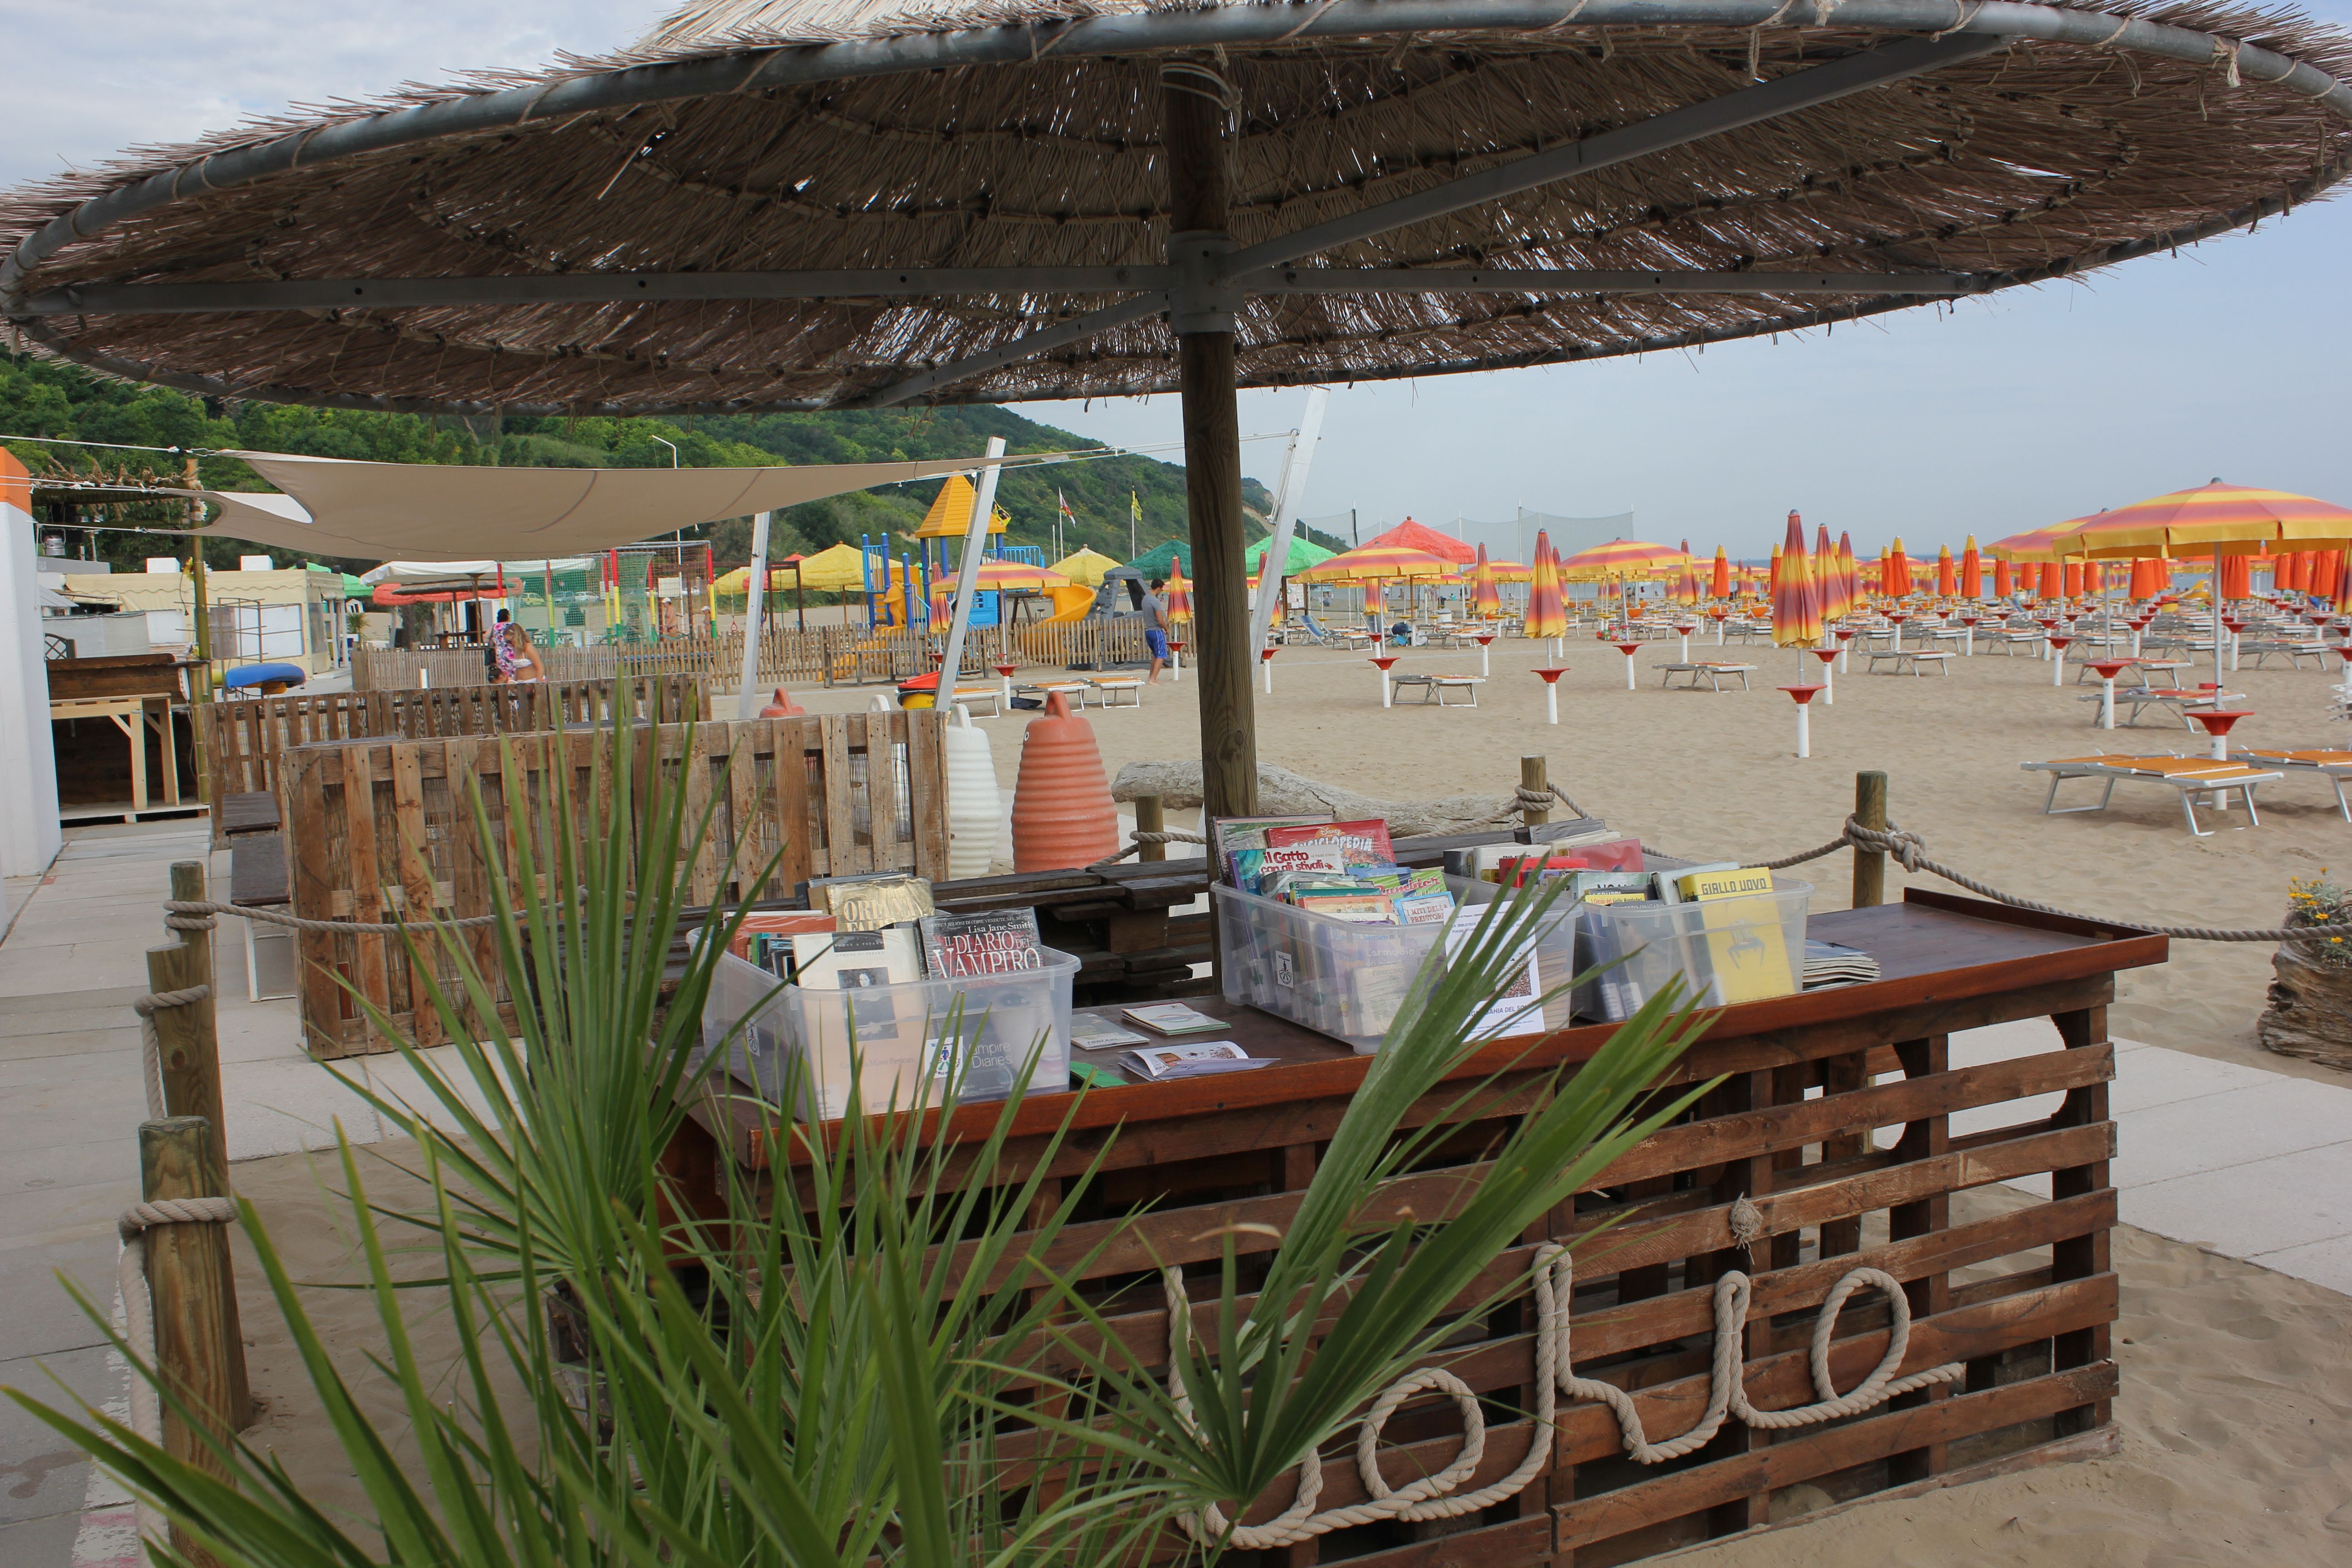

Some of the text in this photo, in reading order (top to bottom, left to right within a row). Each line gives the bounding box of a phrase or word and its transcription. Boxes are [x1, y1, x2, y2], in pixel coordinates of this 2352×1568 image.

[1263, 850, 1309, 864] il Gatto
[1296, 859, 1325, 871] stivali
[1701, 878, 1767, 895] GIALLO UOVO
[843, 897, 917, 922] ORIANA
[967, 921, 1034, 934] Lisa Jane Smith
[944, 931, 1033, 955] IL DIARIO DEL
[932, 947, 1041, 978] VAMPIRO
[962, 1042, 1011, 1056] Vampire
[971, 1054, 1013, 1068] Diaries
